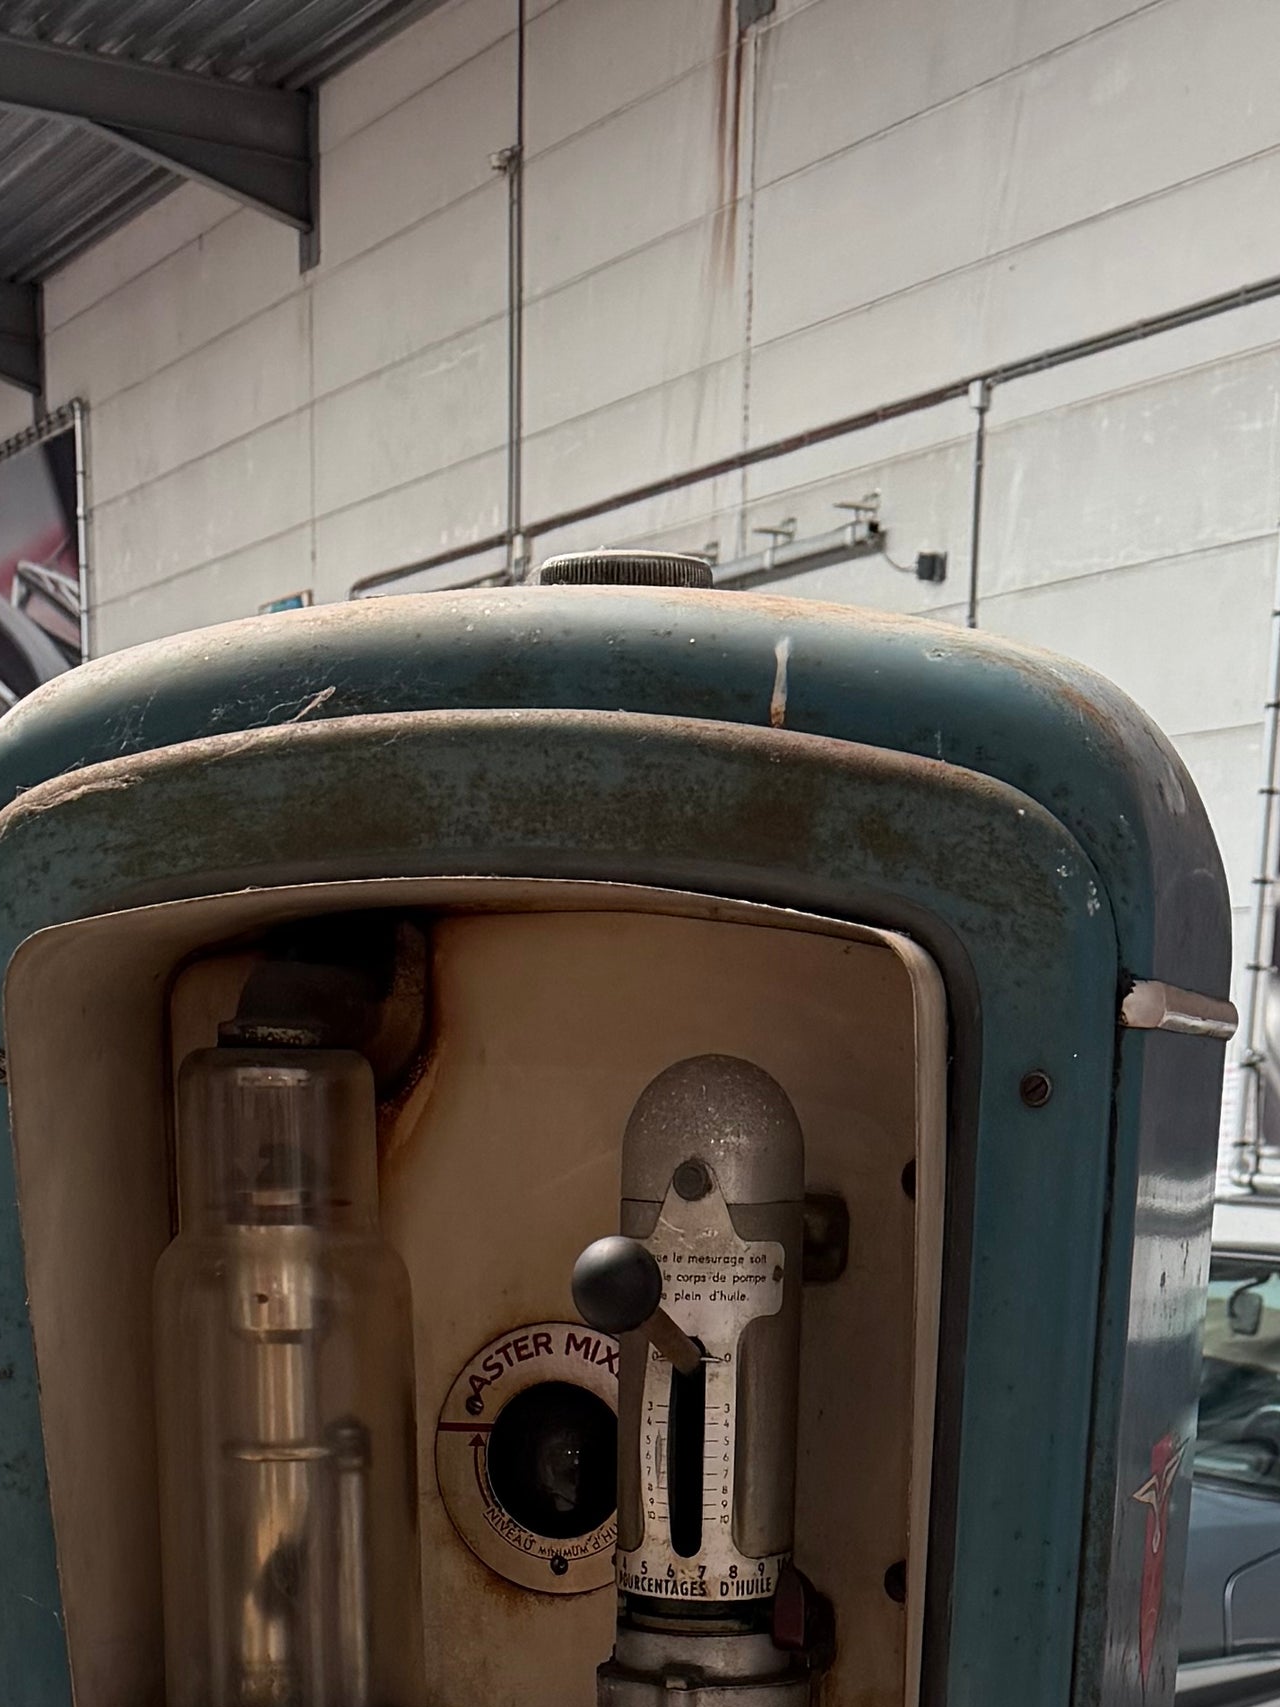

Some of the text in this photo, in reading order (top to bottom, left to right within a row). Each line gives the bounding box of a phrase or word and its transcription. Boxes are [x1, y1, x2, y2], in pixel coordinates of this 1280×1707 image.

[688, 1255, 745, 1267] mesurage
[676, 1274, 706, 1284] corps
[712, 1271, 726, 1283] de
[732, 1276, 767, 1285] pompe
[674, 1289, 702, 1302] plein
[709, 1289, 751, 1302] d'huile.
[564, 1332, 620, 1382] MIX
[724, 1352, 732, 1363] 0
[486, 1507, 536, 1549] NIVEAU
[592, 1523, 619, 1557] d'HU
[641, 1561, 648, 1575] 5
[667, 1564, 675, 1578] 6
[697, 1565, 707, 1580] 7
[728, 1564, 738, 1580] 8
[757, 1562, 765, 1577] 9
[619, 1570, 772, 1597] POURCENTAGES D'HUILE
